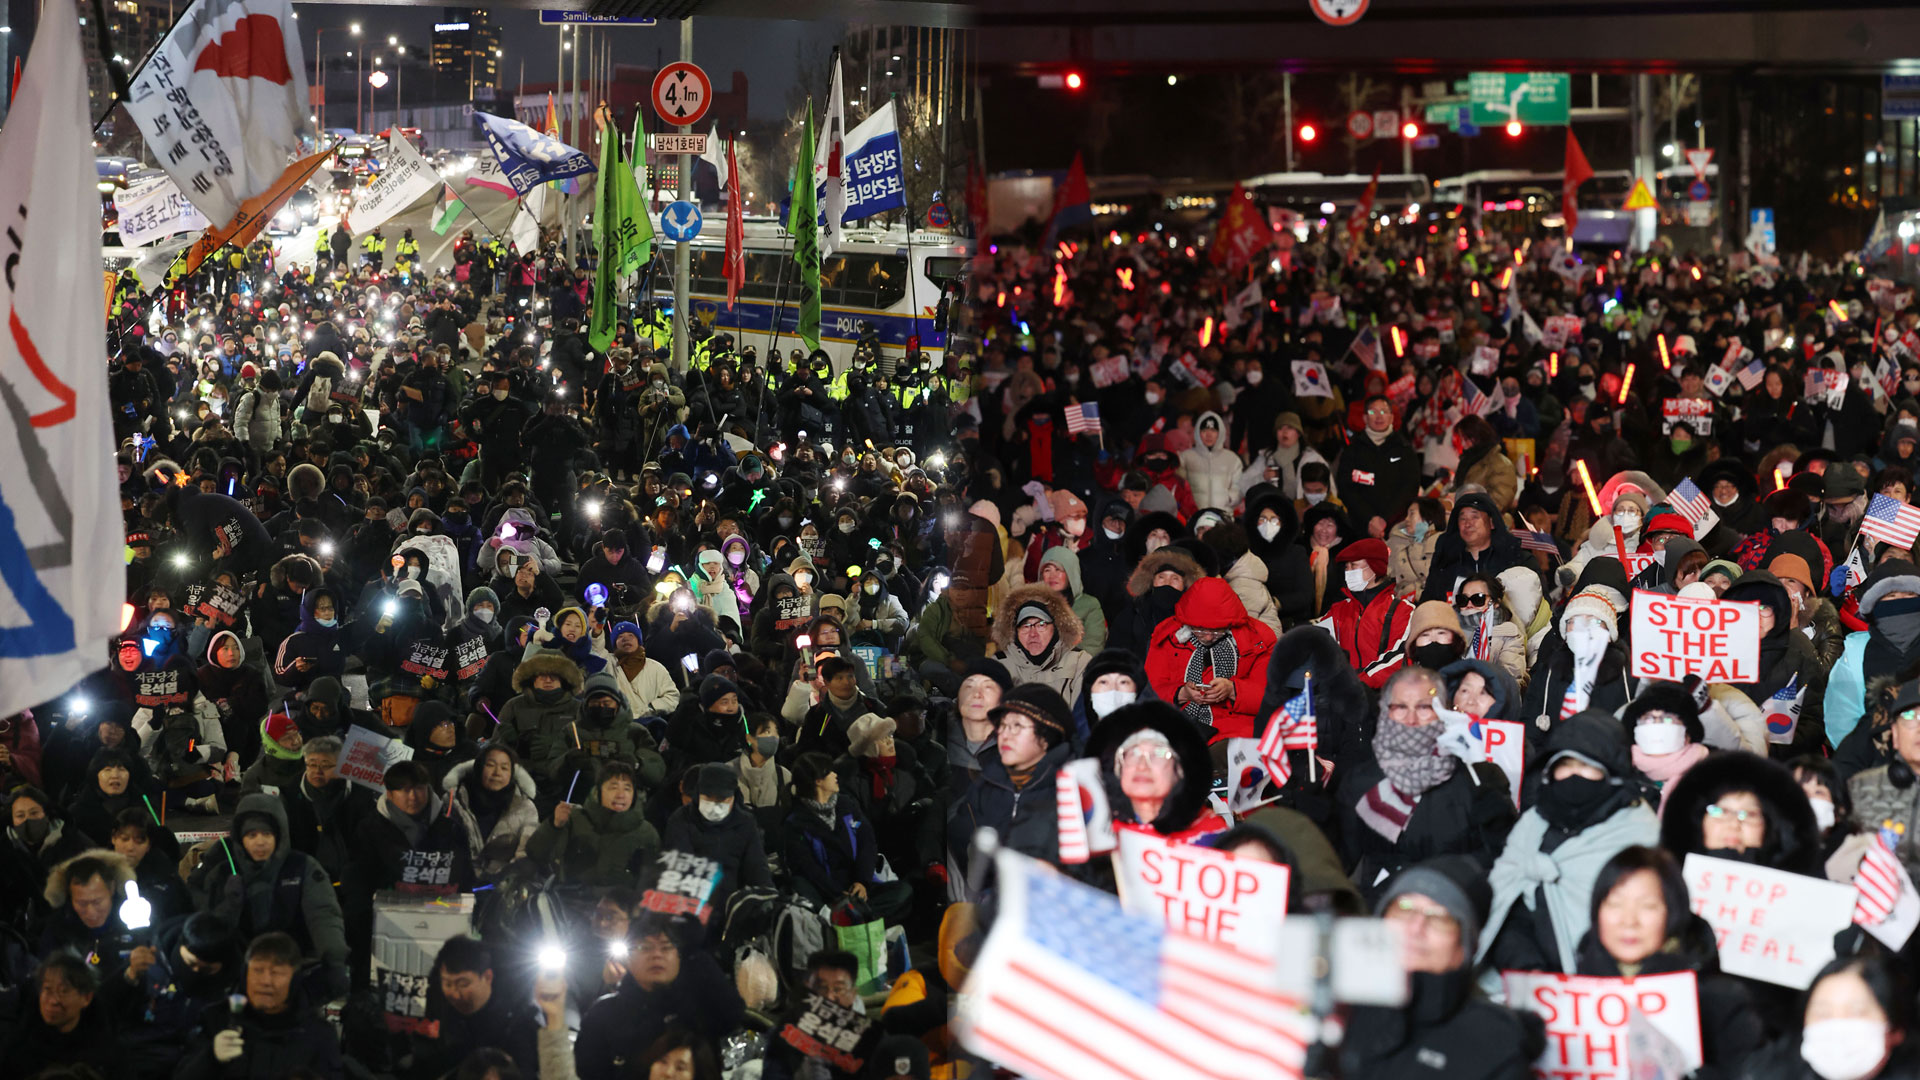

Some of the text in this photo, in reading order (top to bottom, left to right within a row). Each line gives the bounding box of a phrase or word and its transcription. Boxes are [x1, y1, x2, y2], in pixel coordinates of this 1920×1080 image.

[665, 83, 698, 106] 4.1m
[657, 137, 704, 150] 남산1호터널
[777, 595, 812, 609] 지금당장
[780, 606, 811, 620] 윤석열
[1648, 601, 1741, 631] STOP
[410, 642, 450, 659] 지금당장
[1659, 629, 1728, 657] THE
[409, 652, 445, 669] 윤석열
[459, 645, 488, 669] 윤석열
[1640, 652, 1750, 681] STEAL
[135, 670, 179, 684] 지금당장
[140, 681, 178, 696] 윤석열
[400, 849, 455, 866] 지금당장
[402, 866, 451, 884] 윤석열
[1141, 849, 1259, 905] STOP
[1697, 871, 1787, 904] STOP
[1693, 897, 1767, 928] THE
[1714, 927, 1803, 966] TEAL
[1533, 986, 1667, 1027] STOP
[797, 1011, 862, 1053] 윤석열
[1546, 1029, 1618, 1066] TH
